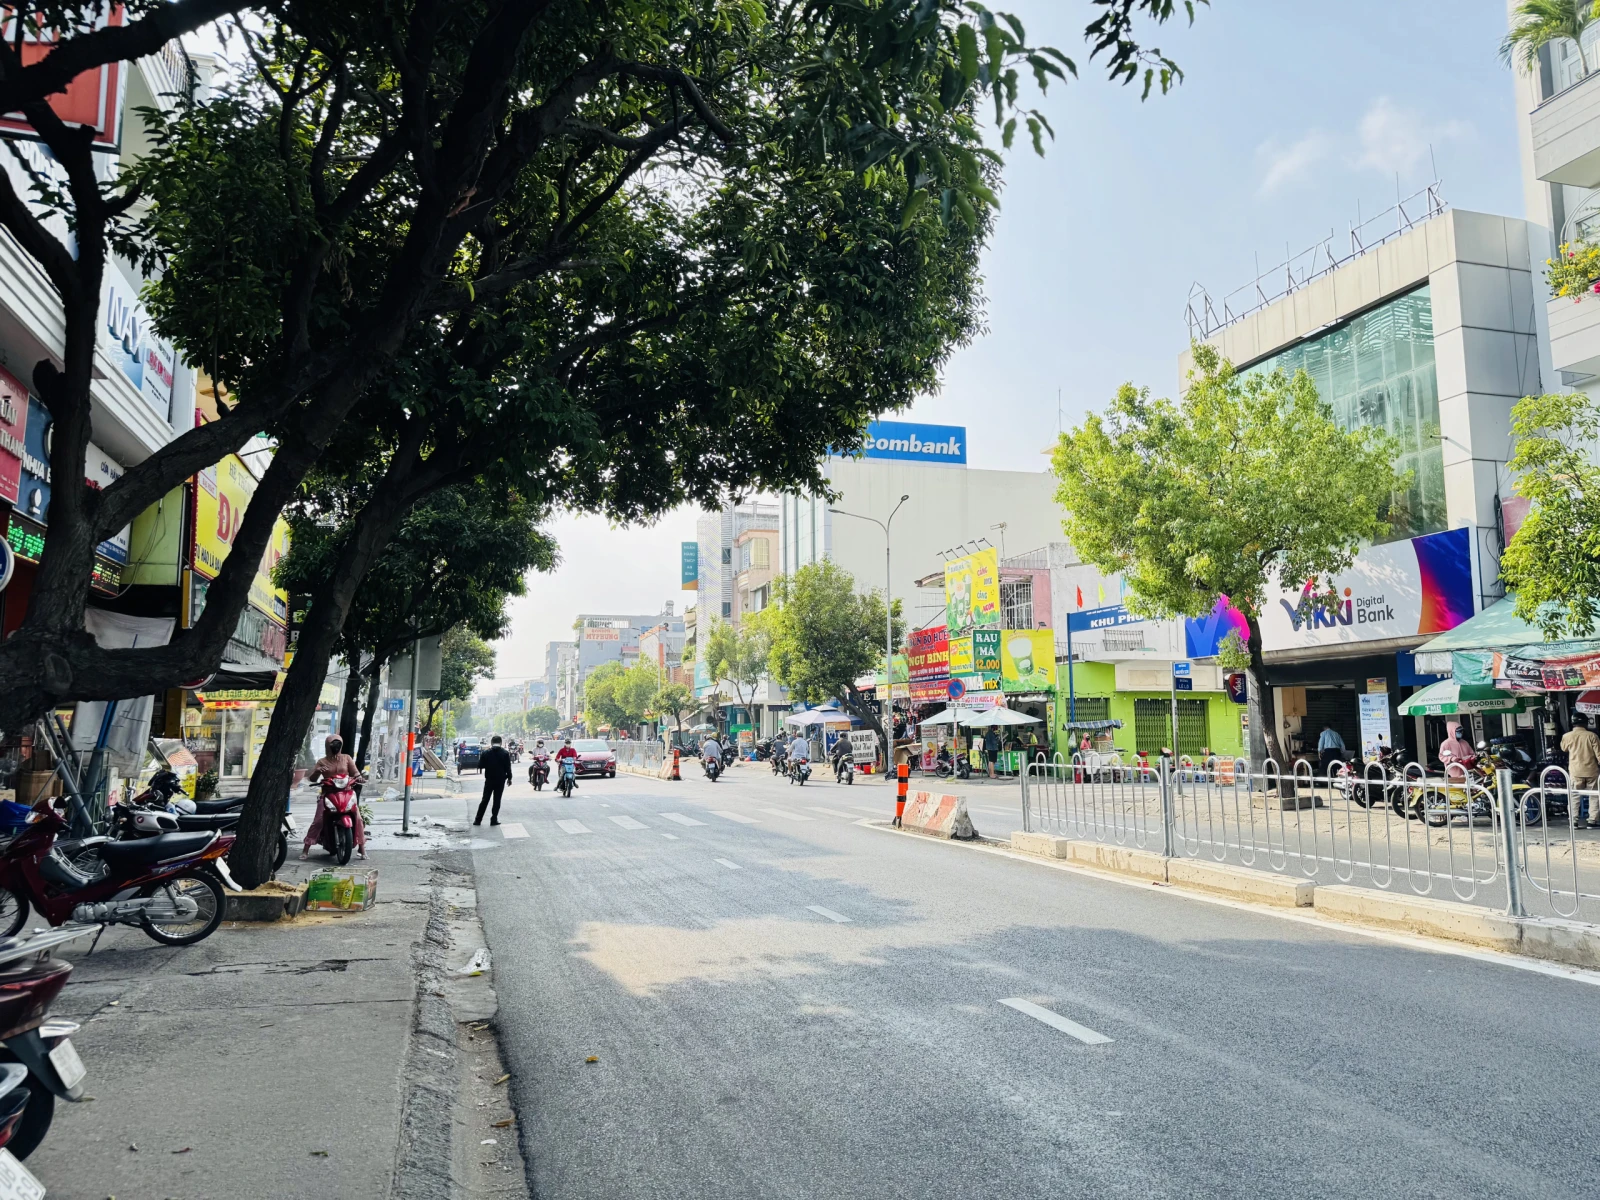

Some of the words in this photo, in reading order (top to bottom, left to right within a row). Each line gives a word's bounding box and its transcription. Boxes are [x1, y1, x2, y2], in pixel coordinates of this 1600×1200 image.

[1356, 595, 1385, 608] Digital
[1357, 604, 1395, 624] Bank
[1090, 616, 1115, 628] KHU
[976, 633, 998, 642] RAU
[979, 645, 995, 656] MÁ
[909, 655, 926, 668] NGỤ
[976, 659, 1000, 670] 12.000
[984, 678, 998, 689] mix
[1233, 677, 1242, 696] Vikki
[1425, 705, 1442, 713] TMB
[1468, 700, 1505, 708] GOODRIDE
